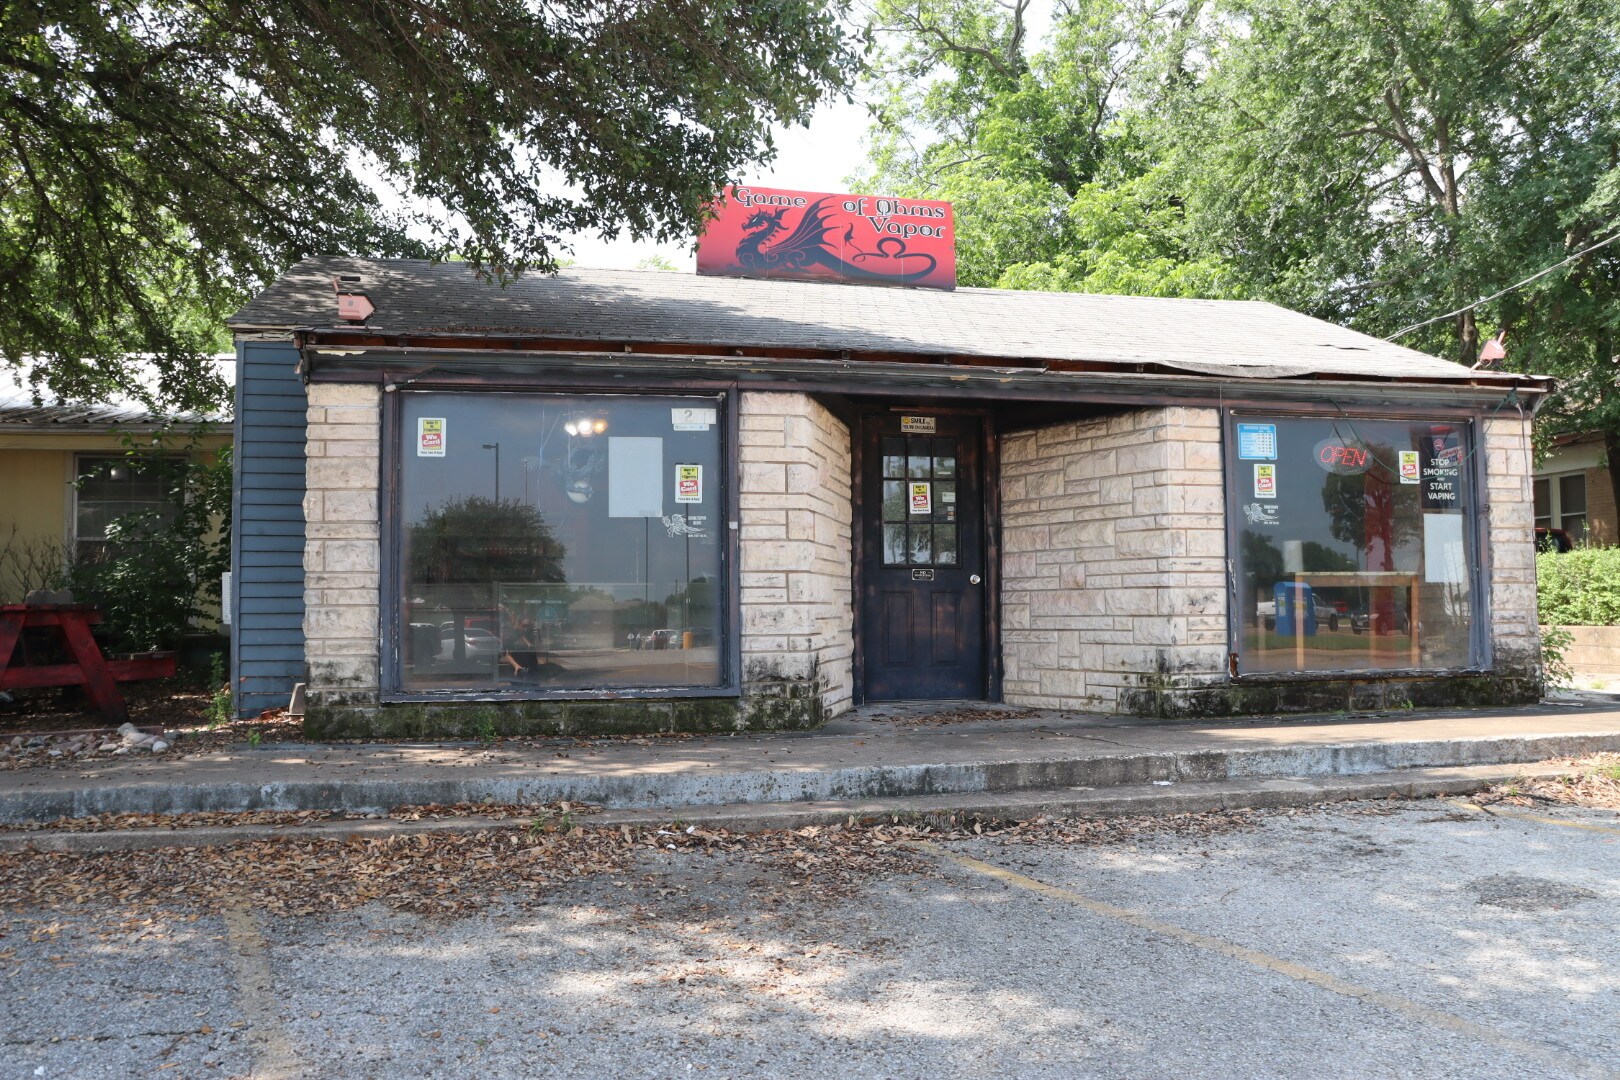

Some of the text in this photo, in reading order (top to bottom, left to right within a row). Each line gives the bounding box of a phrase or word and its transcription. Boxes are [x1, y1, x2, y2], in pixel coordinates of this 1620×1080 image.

[734, 187, 808, 208] Game
[842, 197, 869, 216] of
[866, 215, 946, 239] Vapor
[1320, 446, 1367, 467] OPEN
[1430, 458, 1450, 466] STOP
[1423, 467, 1458, 476] SMOKING
[1429, 482, 1453, 490] START
[1427, 491, 1456, 500] VAPING
